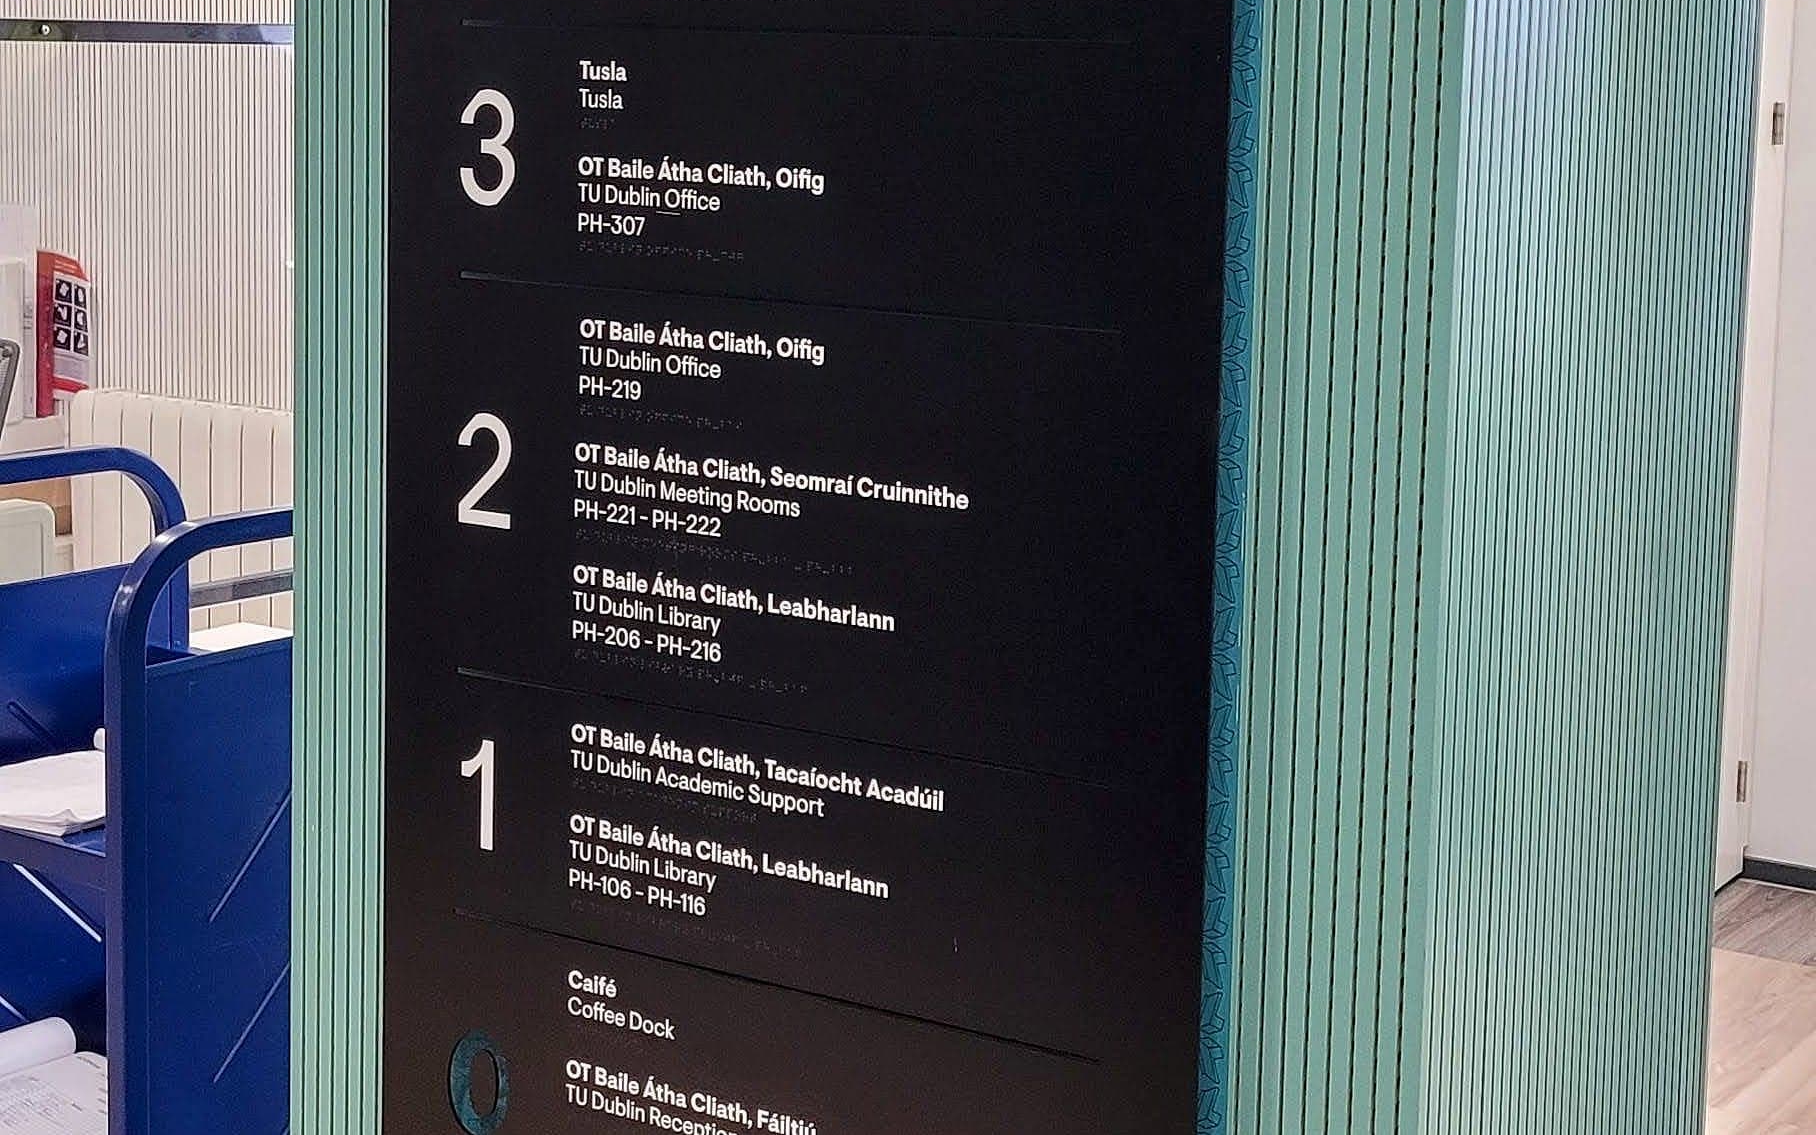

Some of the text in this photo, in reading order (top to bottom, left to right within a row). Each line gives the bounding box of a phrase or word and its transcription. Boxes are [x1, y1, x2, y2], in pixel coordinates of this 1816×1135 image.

[579, 59, 628, 82] Tusla
[578, 86, 624, 110] Tusla
[459, 88, 516, 207] 3
[577, 181, 721, 212] TU Dublin Office
[578, 154, 825, 196] OT Baile Átha Cliath, Oifig
[577, 211, 646, 237] PH-307
[578, 344, 722, 380] TU Dublin Office
[579, 317, 825, 367] OT Baile Átha Cliath, Oifig
[578, 374, 642, 401] PH-219
[457, 412, 512, 530] 2
[574, 441, 970, 511] OT Baile Átha Cliath, Seomraí Cruinnithe
[574, 468, 801, 519] TU Dublin Meeting Rooms
[574, 497, 636, 526] PH-221
[652, 507, 722, 539] PH-222
[572, 590, 722, 638] TU Dublin Library
[573, 563, 895, 633] OT Baile Átha Cliath, Leabharlann
[572, 619, 641, 650] PH-206
[656, 632, 722, 664] PH-216
[570, 722, 945, 813] OT Baile Átha Cliath, Tacaíocht Acadúil
[570, 748, 593, 772] TU
[596, 752, 652, 784] Dublin
[654, 765, 745, 802] Academic
[747, 782, 825, 818] Support
[460, 739, 495, 851] 1
[568, 838, 717, 894] TU Dublin Library
[569, 813, 889, 900] OT Baile Átha Cliath, Leabharlann
[568, 866, 632, 901] PH-106
[647, 884, 706, 917] PH-116
[567, 968, 617, 999] Caifé
[567, 994, 675, 1041] Coffee Dock
[565, 1058, 592, 1083] OT
[594, 1064, 640, 1096] Baile
[642, 1074, 688, 1109] Átha
[690, 1091, 753, 1131] Cliath,
[565, 1082, 588, 1107] TU
[591, 1089, 646, 1124] Dublin
